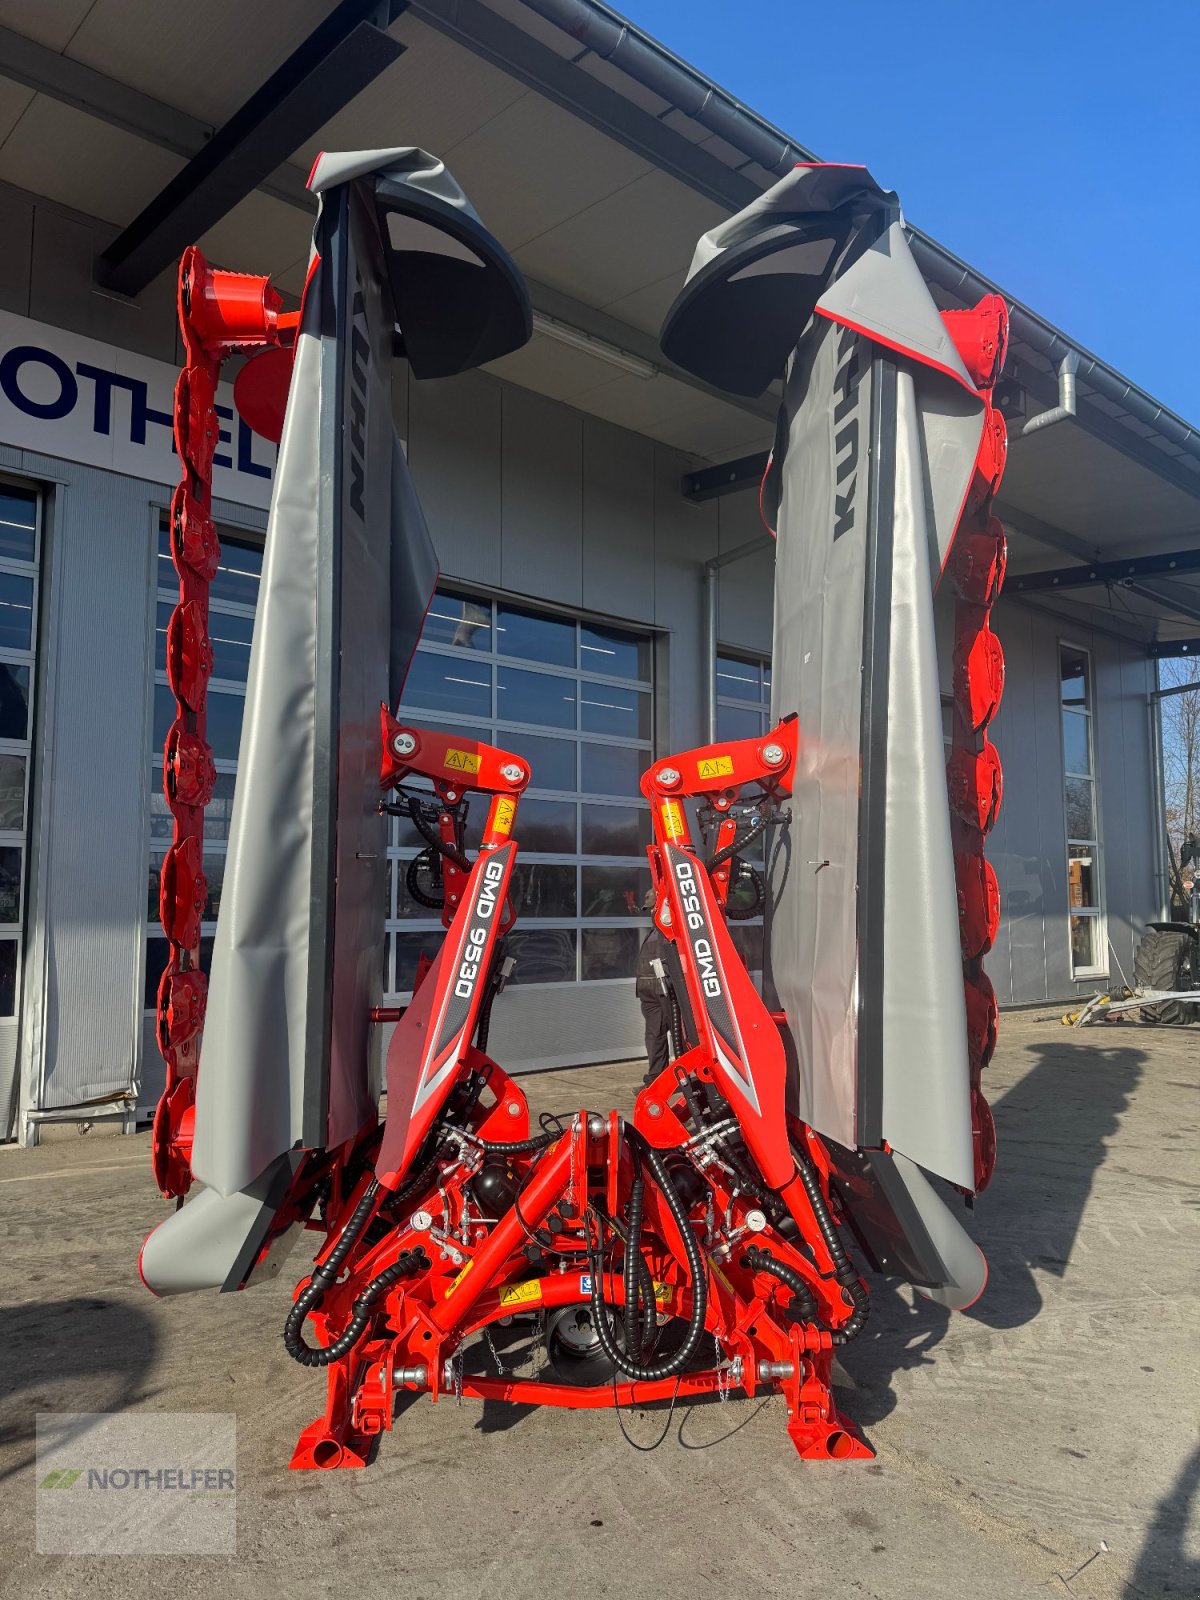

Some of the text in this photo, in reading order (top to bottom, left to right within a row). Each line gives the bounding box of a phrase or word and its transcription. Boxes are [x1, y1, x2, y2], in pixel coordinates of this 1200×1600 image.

[454, 861, 504, 999] GMD 9530
[675, 862, 722, 998] GMD 9530
